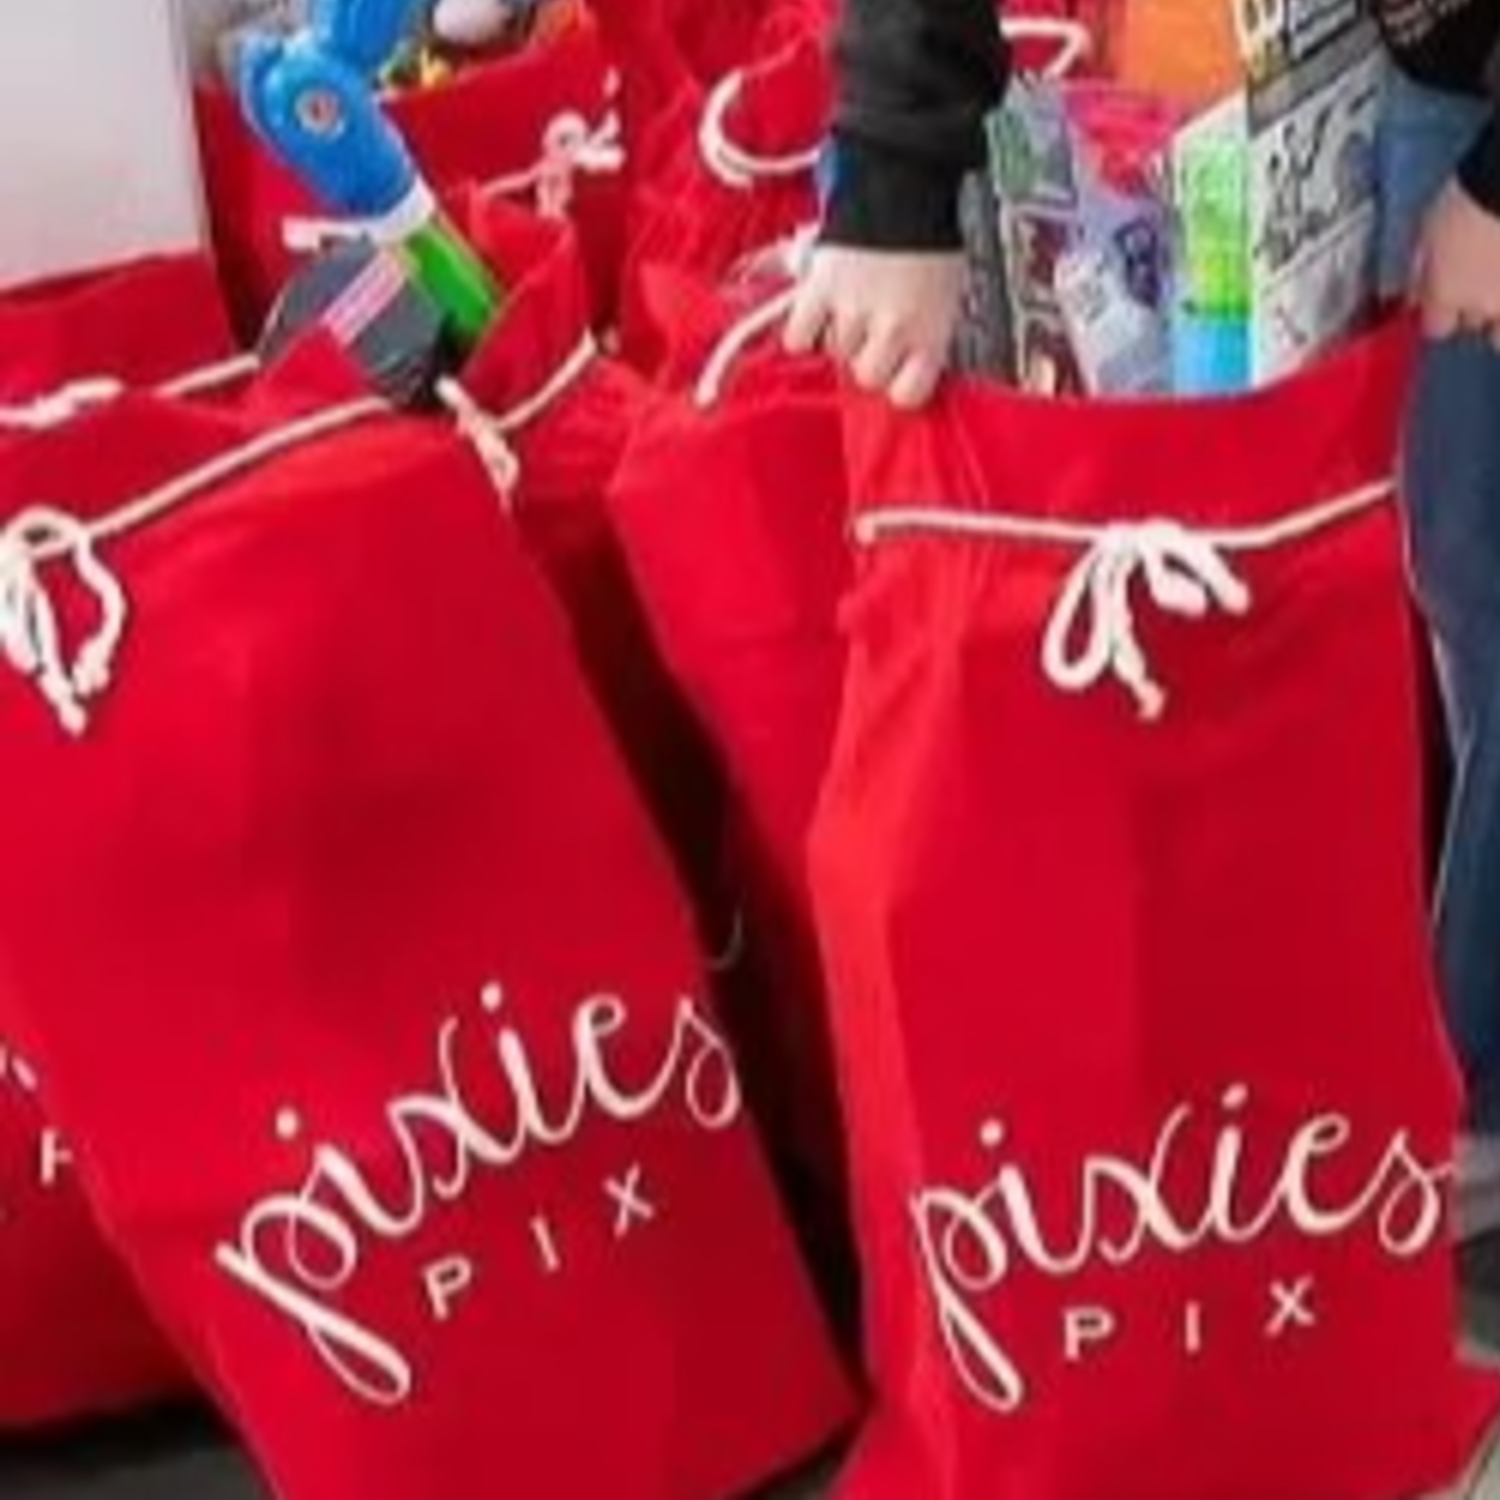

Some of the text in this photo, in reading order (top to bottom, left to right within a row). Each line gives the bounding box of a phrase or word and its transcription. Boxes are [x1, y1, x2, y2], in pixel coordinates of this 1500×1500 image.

[213, 981, 741, 1403] pixies
[423, 1163, 655, 1320] PIX
[909, 1083, 1456, 1411] pixies
[1062, 1274, 1316, 1360] PIX
